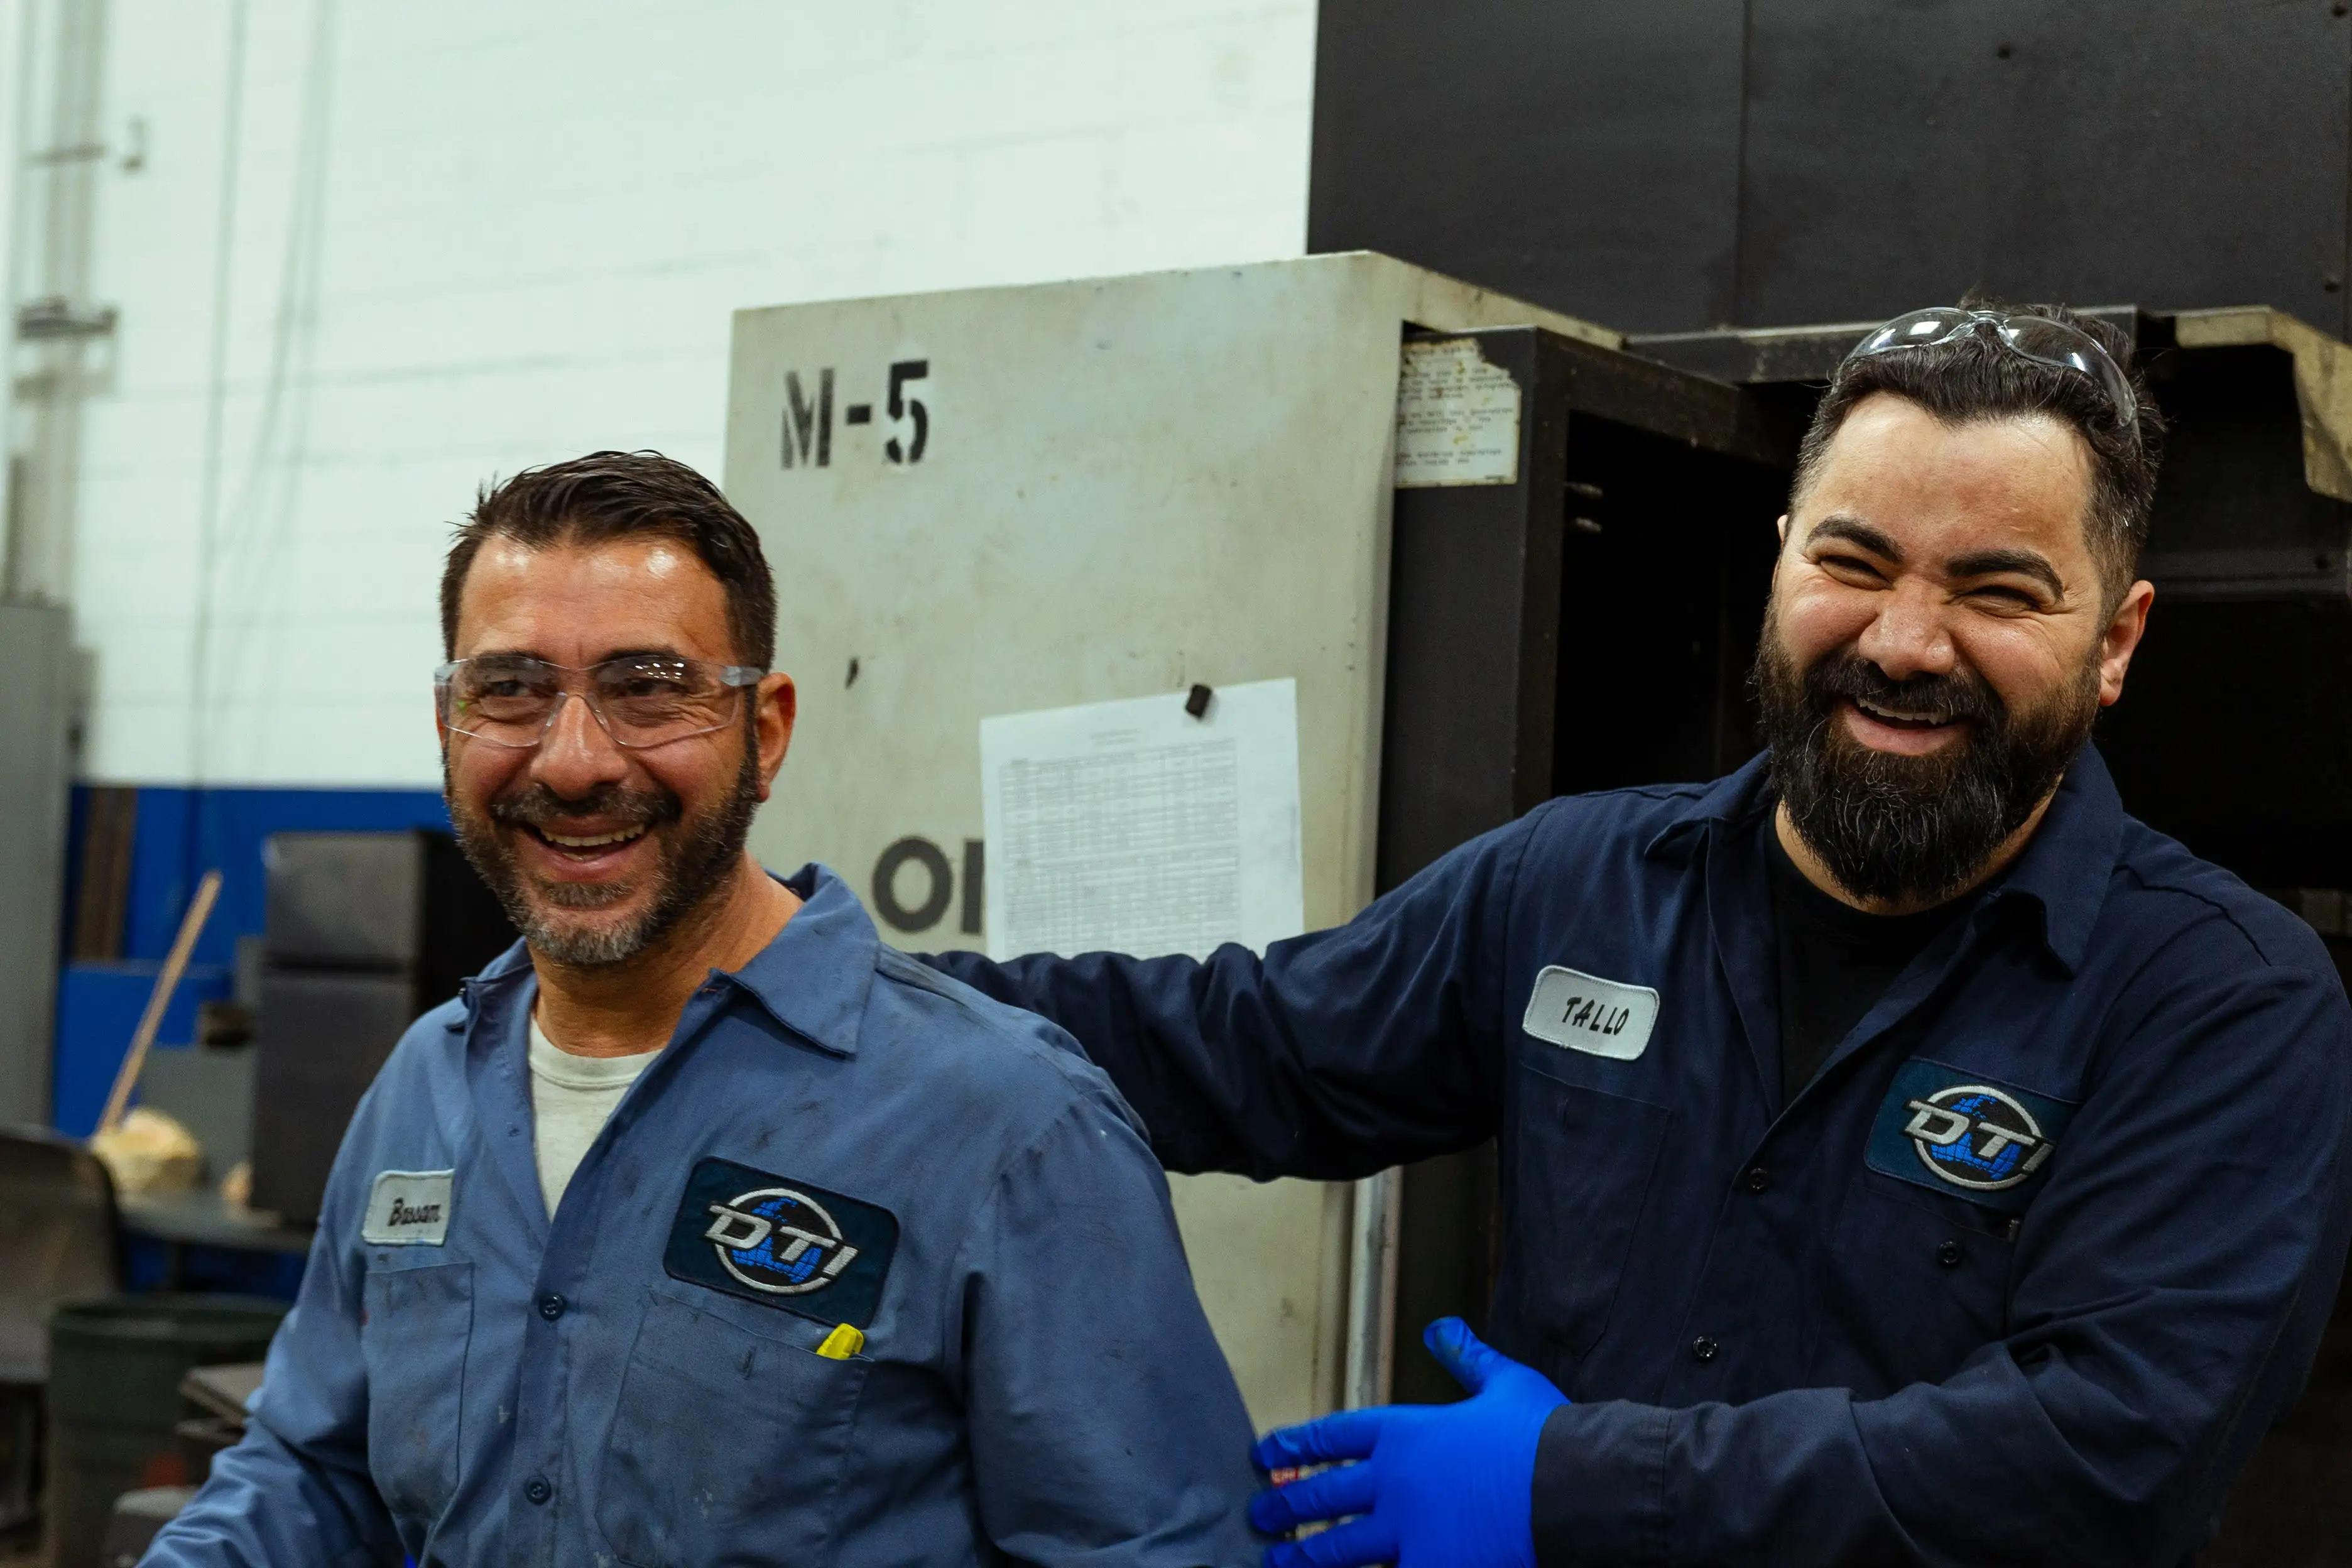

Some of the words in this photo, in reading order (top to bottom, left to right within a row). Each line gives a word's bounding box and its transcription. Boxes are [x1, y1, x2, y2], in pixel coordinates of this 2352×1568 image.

[781, 359, 929, 470] M-5
[1562, 996, 1630, 1036] TALLO
[1905, 1101, 2055, 1173] DTI
[704, 1204, 859, 1276] DTI
